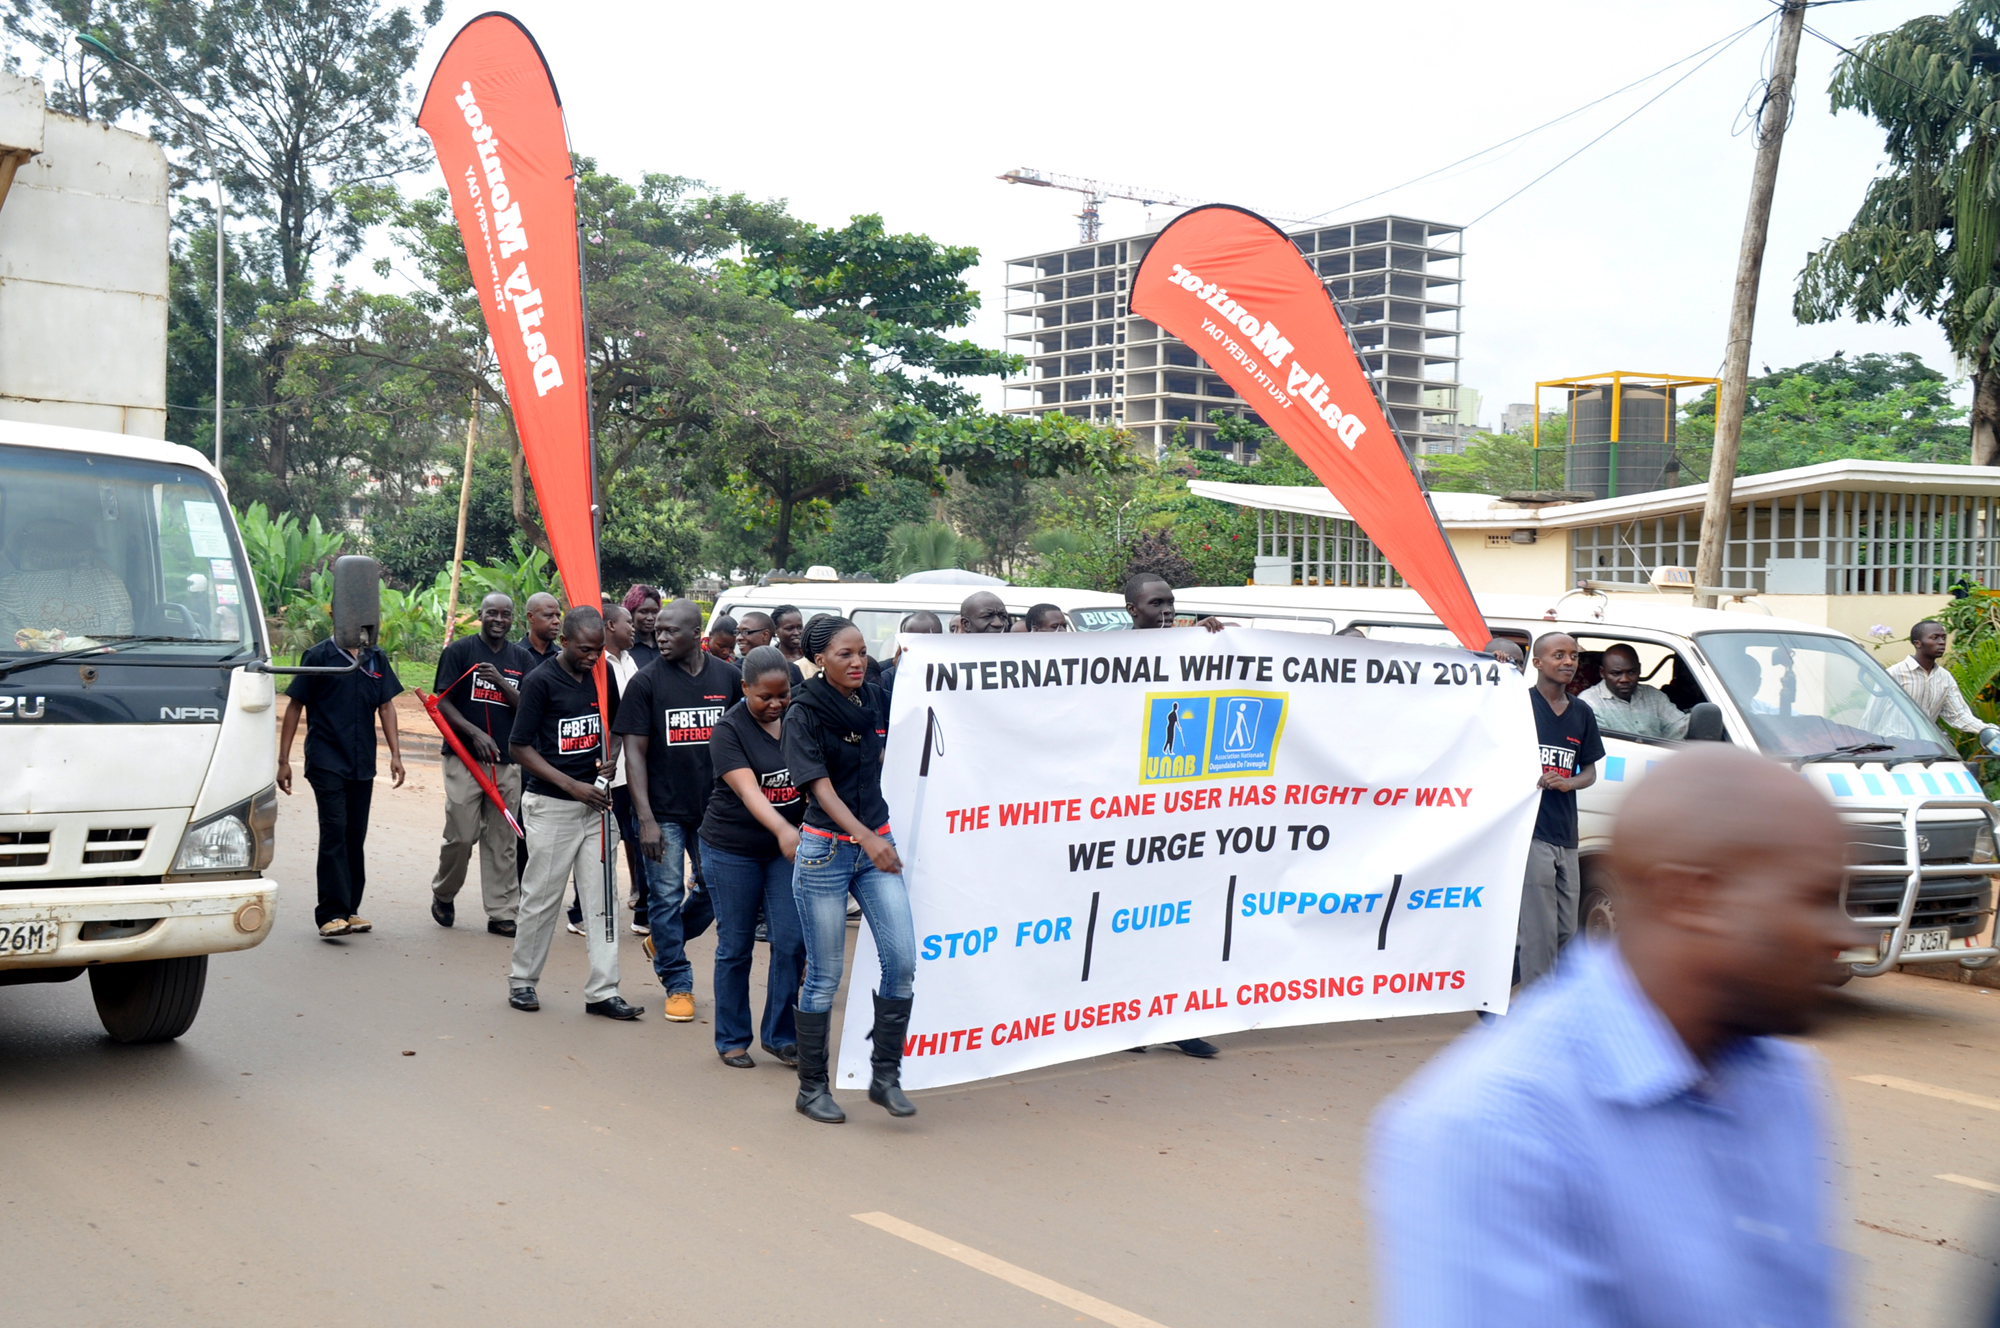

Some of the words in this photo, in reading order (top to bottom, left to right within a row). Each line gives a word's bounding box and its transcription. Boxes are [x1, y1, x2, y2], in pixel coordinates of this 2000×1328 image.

[1666, 570, 1689, 583] TAXI
[1080, 611, 1134, 626] BUSI
[926, 656, 1169, 692] INTERNATIONAL
[1179, 655, 1273, 682] WHITE
[1283, 657, 1357, 683] CANE
[1366, 659, 1422, 685] DAY
[1432, 662, 1501, 686] 2014
[474, 687, 507, 702] DIFFERE
[160, 706, 220, 720] NPR
[669, 711, 698, 729] #BE
[562, 720, 587, 737] #BE
[587, 716, 601, 735] TH
[669, 726, 714, 742] DIFFEREN
[1214, 752, 1241, 761] Association
[1240, 751, 1265, 760] Nationale
[1236, 760, 1244, 769] De
[1540, 747, 1558, 767] BE
[1557, 750, 1575, 770] THE
[1147, 754, 1197, 779] UNAB
[946, 806, 990, 835] THE
[998, 799, 1083, 828] WHITE
[1090, 793, 1158, 820] CANE
[1163, 787, 1223, 814] USER
[1228, 784, 1278, 807] HAS
[1284, 784, 1370, 806] RIGHT
[1373, 787, 1409, 806] OF
[1415, 787, 1474, 807] WAY
[1067, 840, 1117, 872] WE
[1126, 831, 1206, 867] URGE
[1216, 825, 1278, 856] YOU
[1287, 824, 1330, 852] TO
[920, 925, 999, 962] STOP
[1015, 916, 1073, 948] FOR
[1111, 899, 1193, 934] GUIDE
[1240, 891, 1384, 918] SUPPORT
[1406, 885, 1485, 912] SEEK
[1901, 934, 1915, 952] AP
[991, 1012, 1057, 1046] CANE
[1064, 998, 1142, 1033] USERS
[1147, 993, 1180, 1018] AT
[1184, 987, 1228, 1013] ALL
[1236, 975, 1364, 1006] CROSSING
[1372, 970, 1467, 995] POINTS
